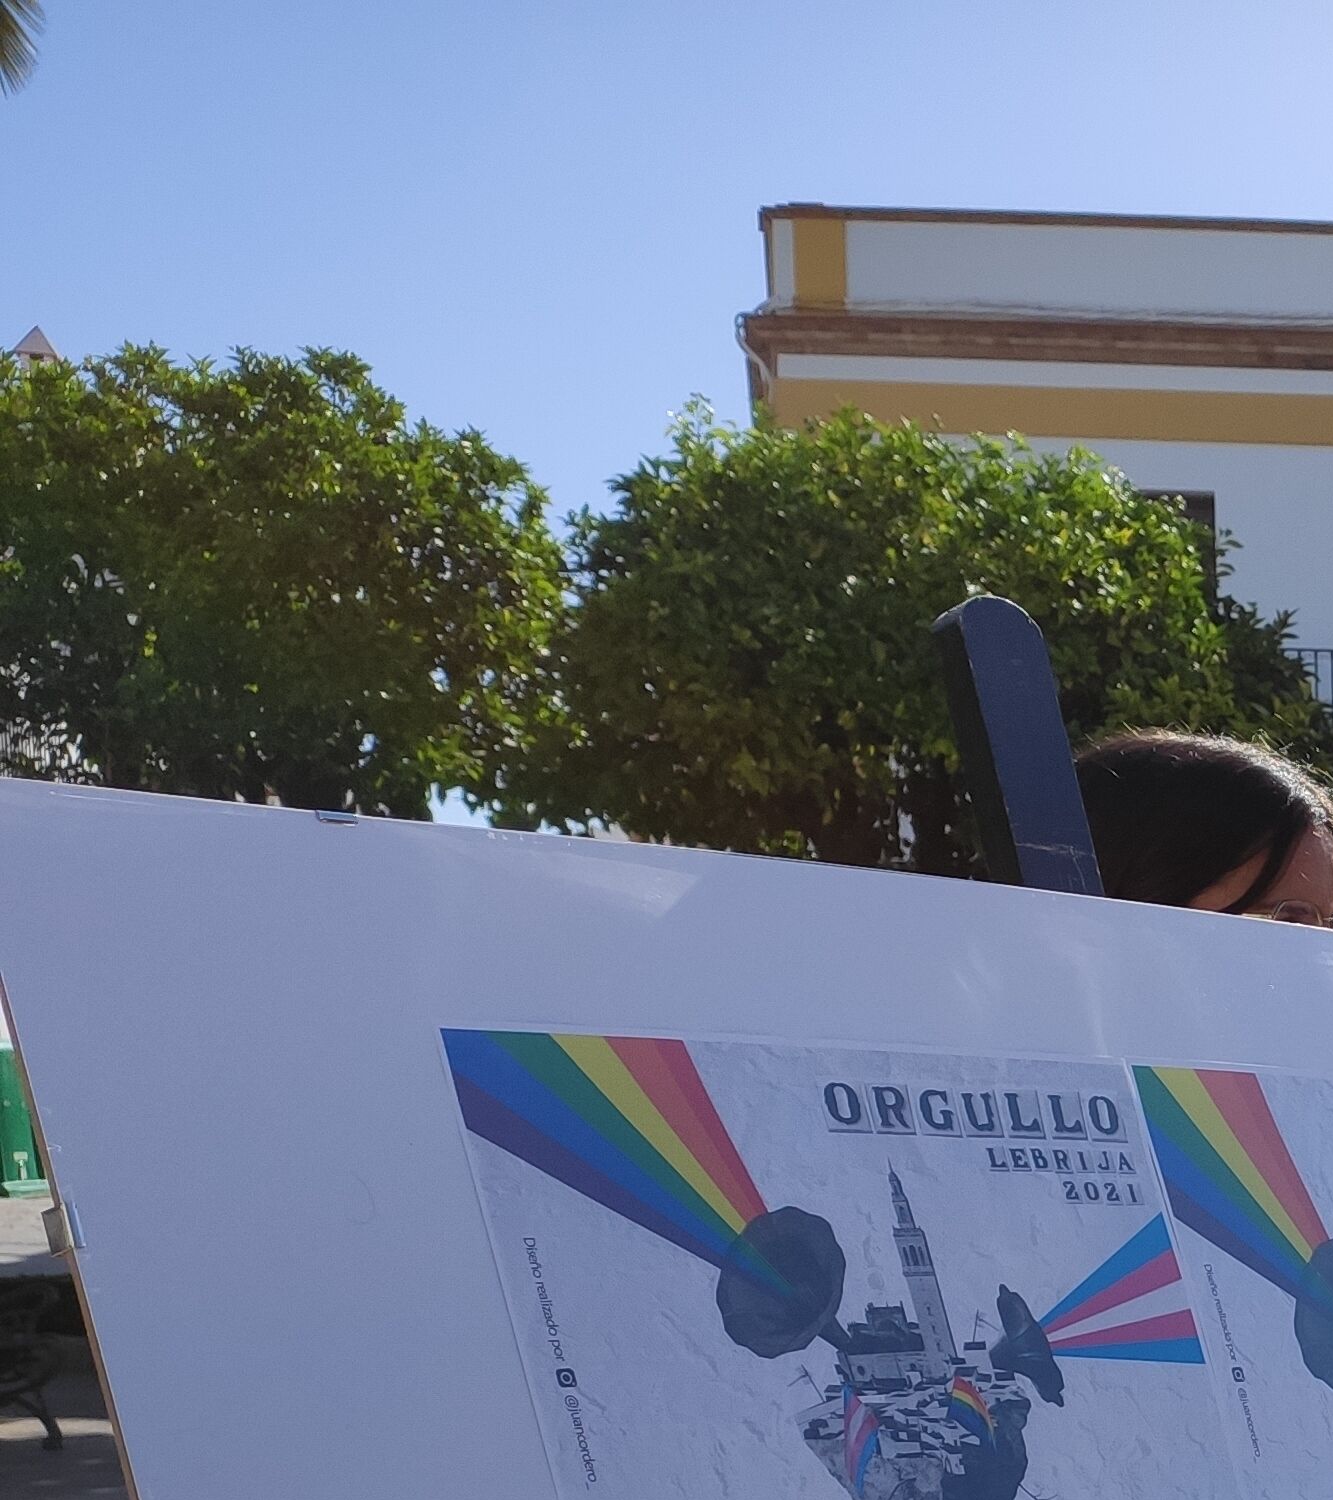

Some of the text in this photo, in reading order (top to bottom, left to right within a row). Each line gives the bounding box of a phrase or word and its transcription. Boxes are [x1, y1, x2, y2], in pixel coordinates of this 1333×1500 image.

[823, 1081, 1120, 1136] ORGULLO
[985, 1147, 1135, 1172] LEBRIJA
[1062, 1180, 1139, 1204] 2021
[522, 1237, 542, 1279] Diseño
[535, 1281, 558, 1337] realizado
[548, 1338, 566, 1362] por
